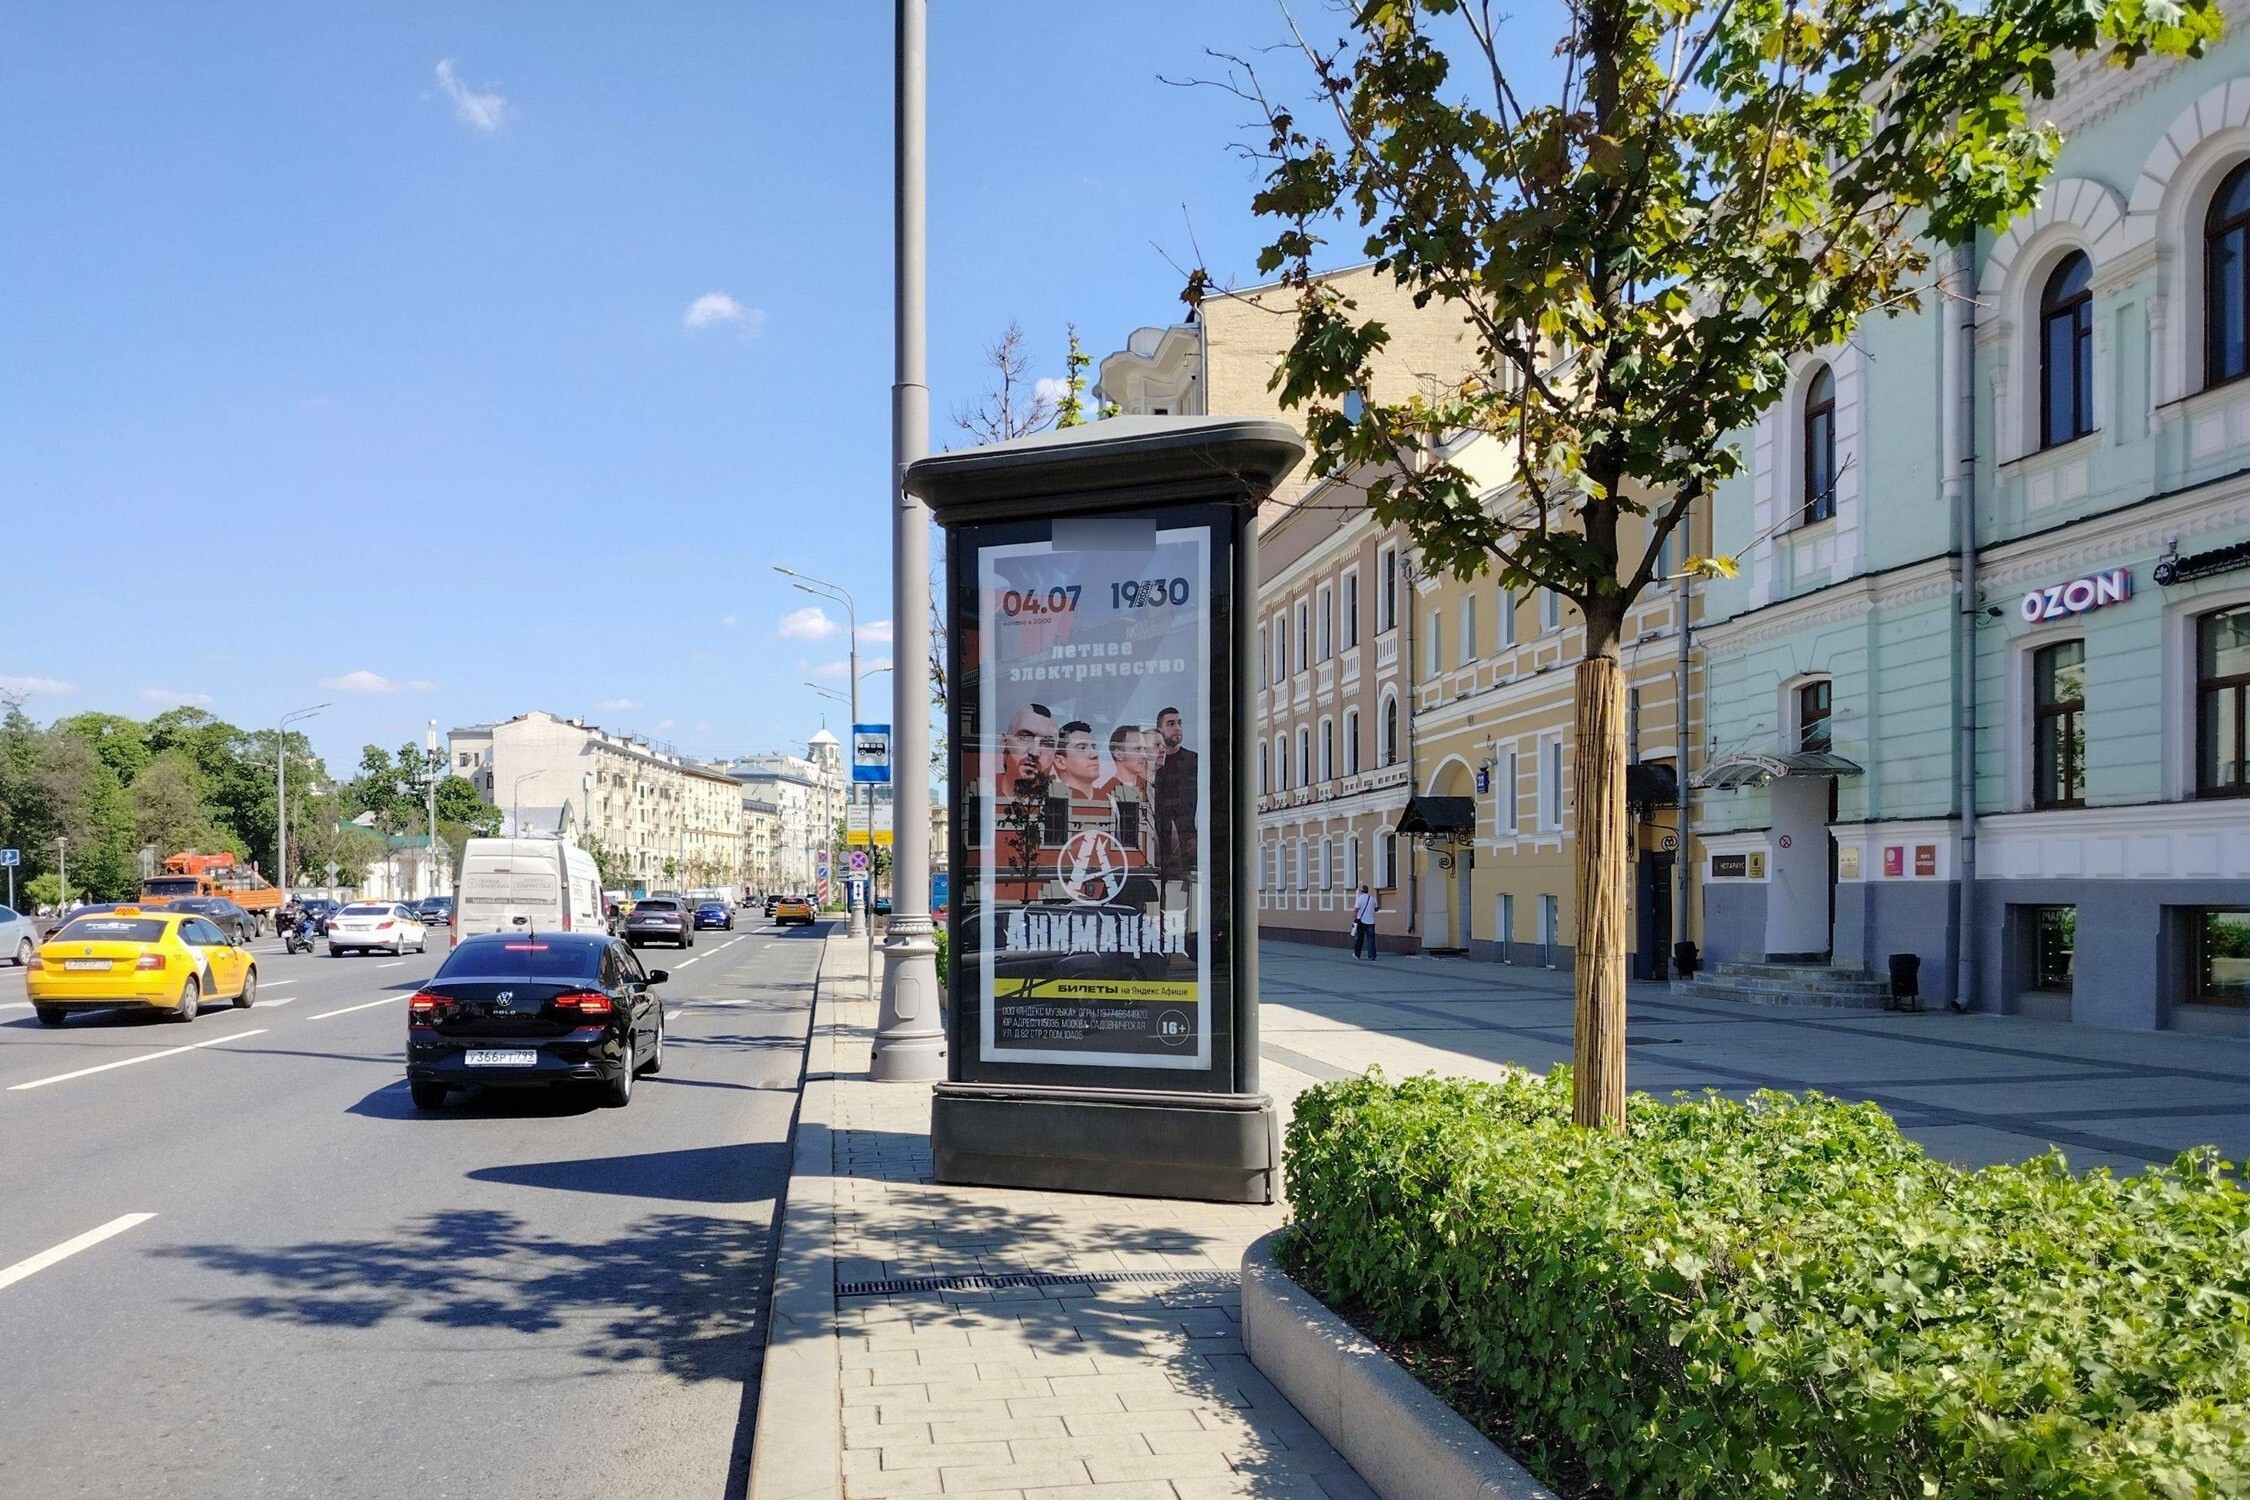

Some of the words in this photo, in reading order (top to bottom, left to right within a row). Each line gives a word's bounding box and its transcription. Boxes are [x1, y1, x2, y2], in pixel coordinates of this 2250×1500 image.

[1003, 585, 1082, 617] 04.07
[2021, 568, 2128, 622] OZON
[1052, 641, 1133, 660] летнее
[1009, 658, 1185, 682] электричество
[1058, 985, 1118, 994] БИЛЕТЫ
[1121, 986, 1131, 994] на
[1132, 986, 1160, 996] Яндекс
[1161, 987, 1189, 997] Афише
[1162, 1021, 1187, 1035] 16+
